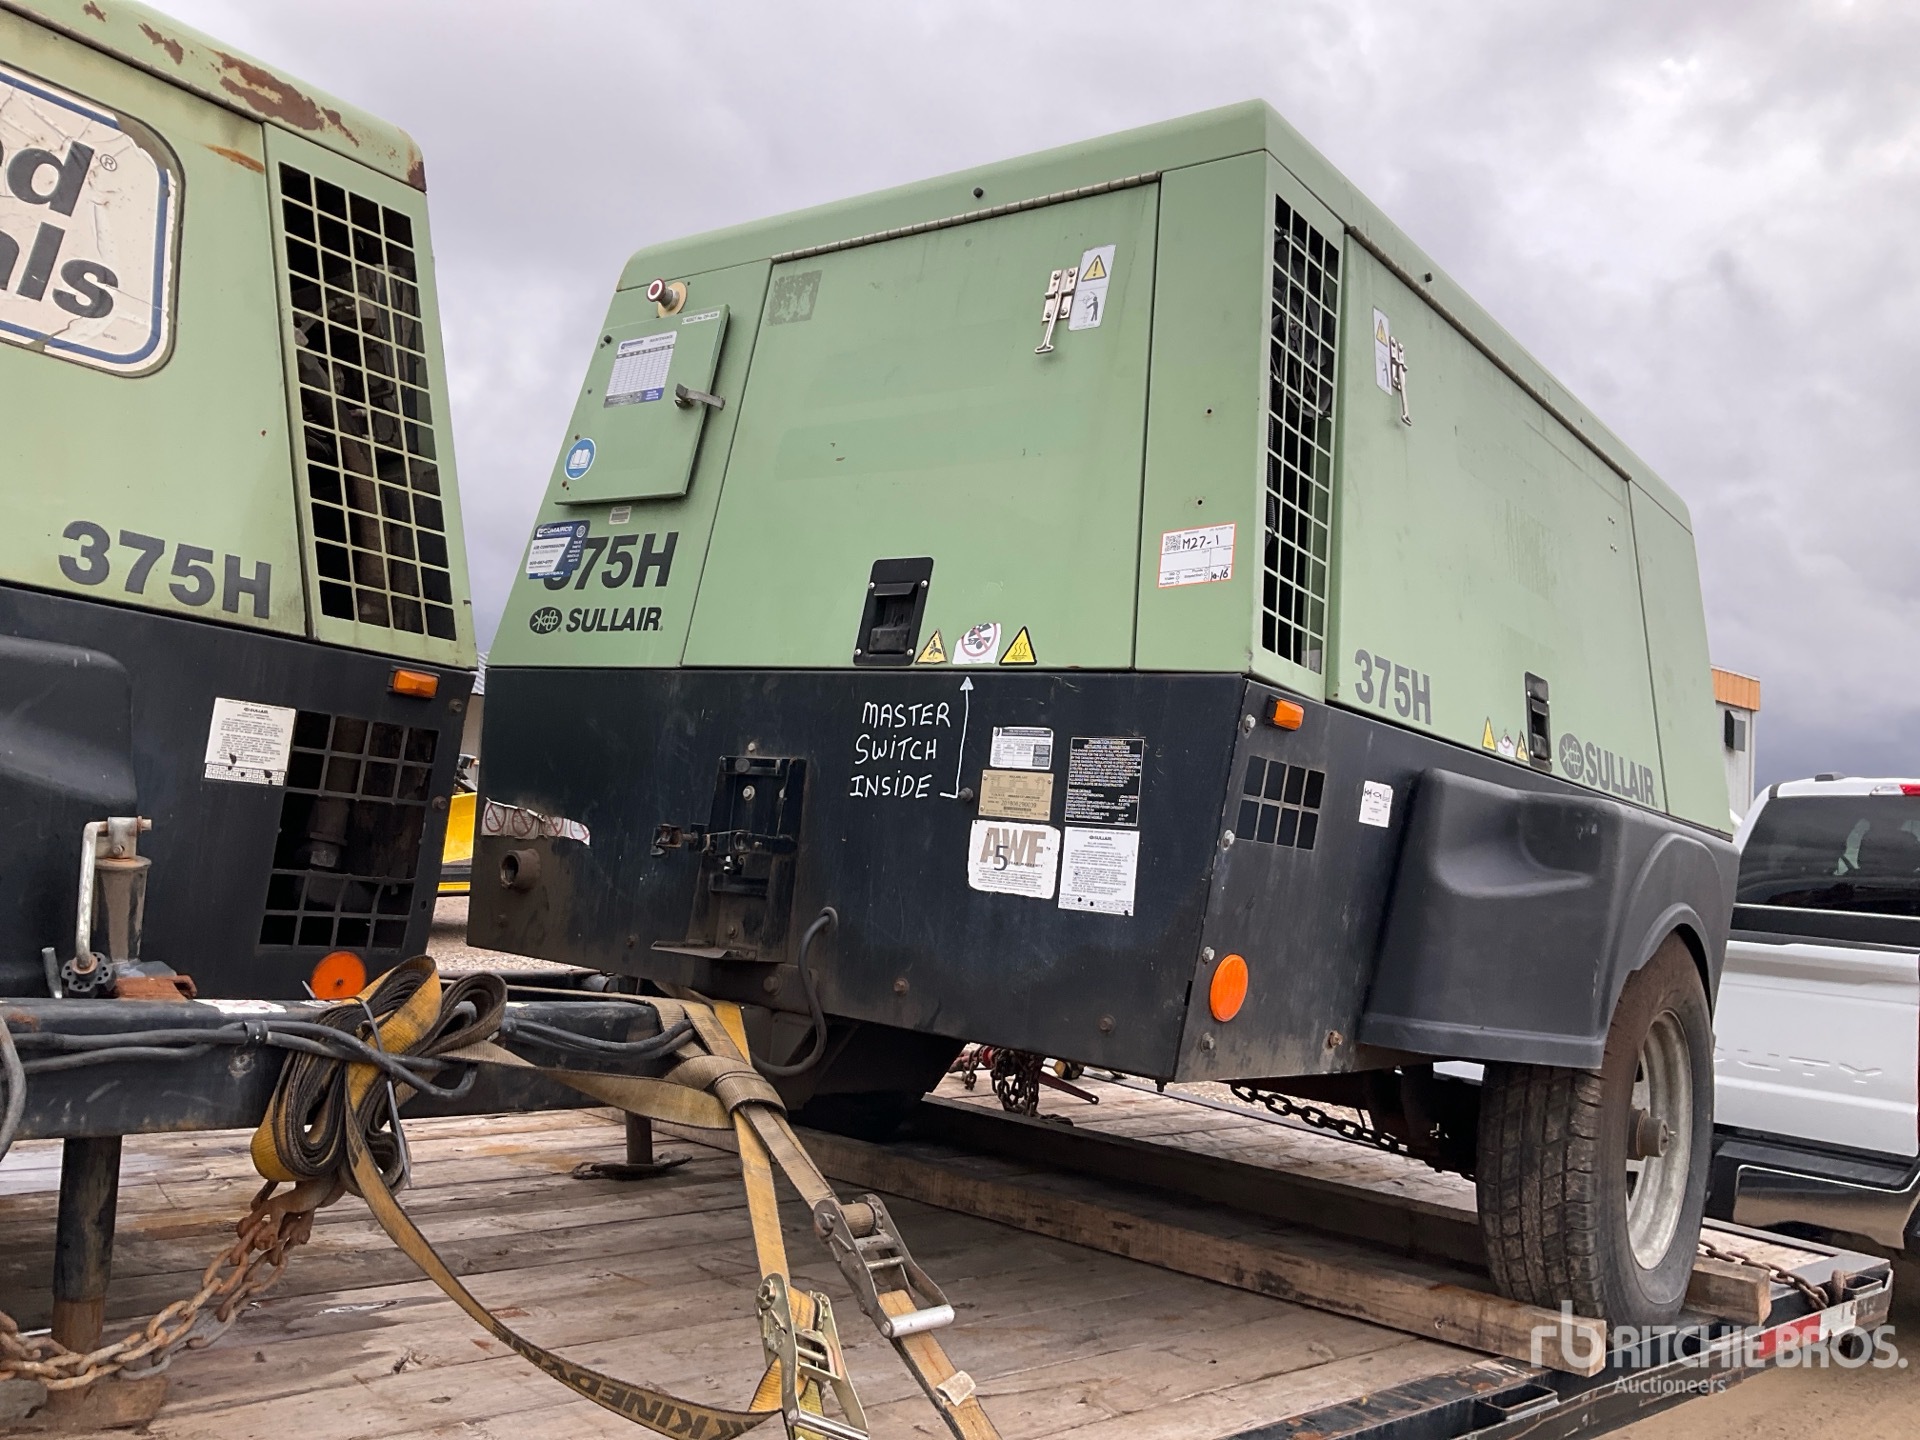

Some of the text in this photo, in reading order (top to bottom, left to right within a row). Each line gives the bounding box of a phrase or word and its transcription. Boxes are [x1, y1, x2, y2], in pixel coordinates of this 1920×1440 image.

[0, 139, 95, 218] d
[58, 520, 271, 620] 375H
[543, 531, 679, 590] 75H
[565, 607, 662, 632] SULLAIR
[861, 701, 951, 729] MASTER
[1354, 649, 1431, 725] 375H
[1584, 741, 1655, 806] SULLAIR
[980, 827, 1046, 866] AWF
[993, 845, 1009, 871] 5
